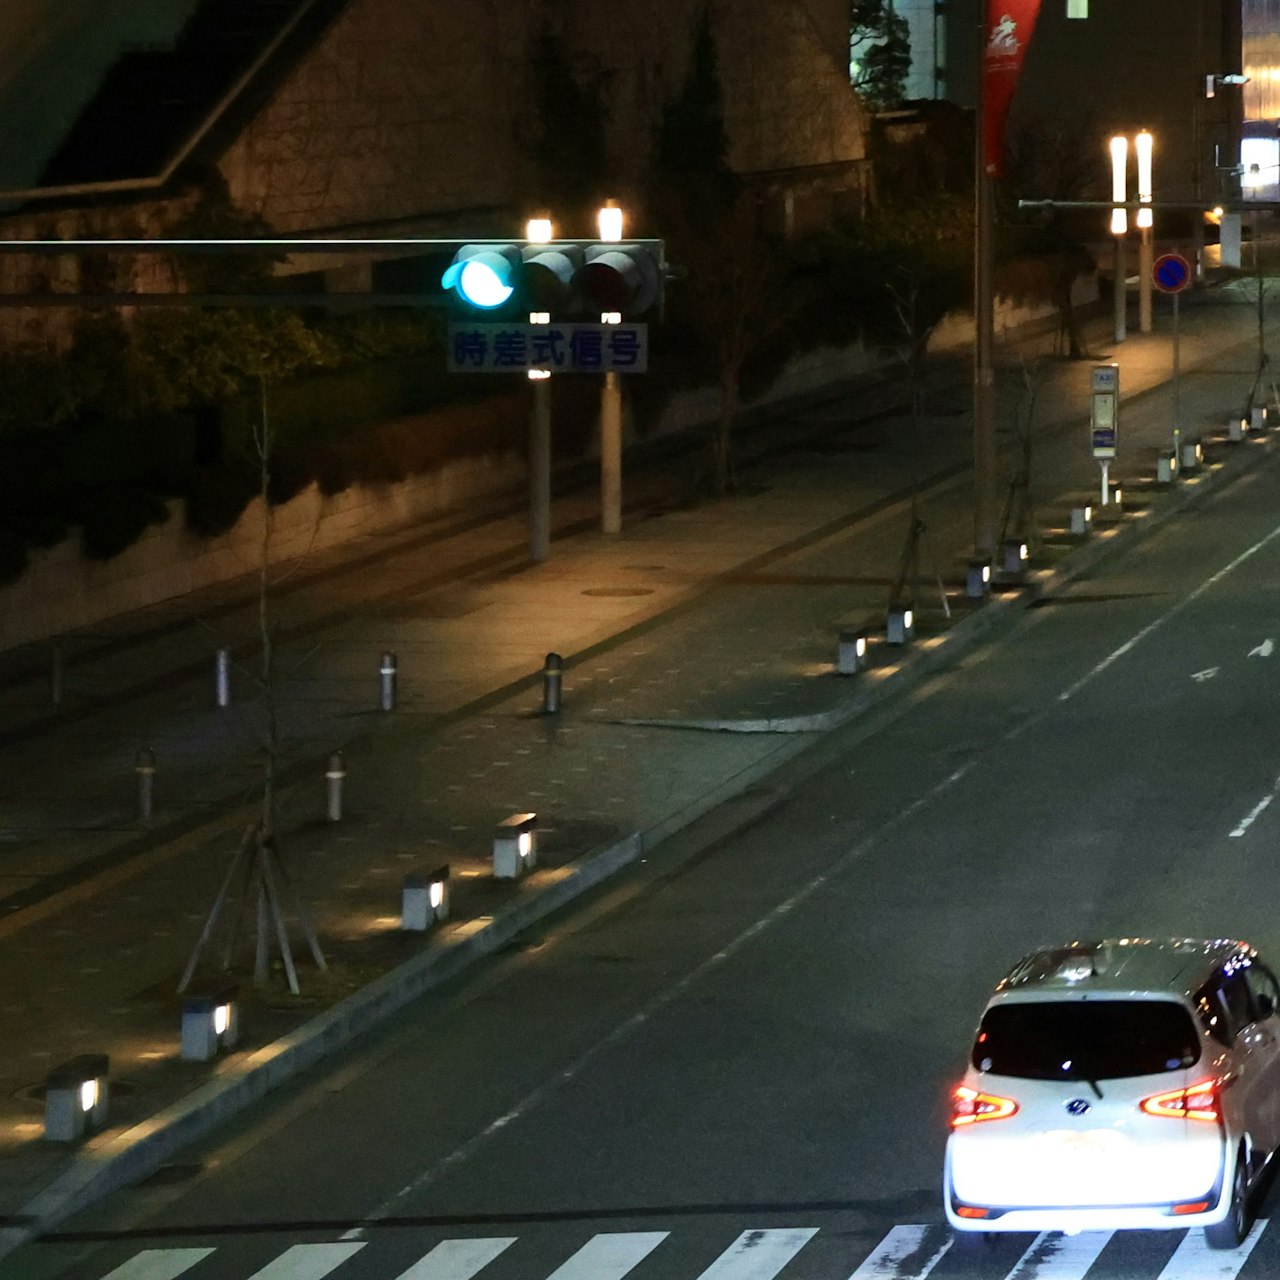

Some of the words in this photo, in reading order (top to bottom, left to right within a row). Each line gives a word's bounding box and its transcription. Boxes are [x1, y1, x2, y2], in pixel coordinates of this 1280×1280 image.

[454, 329, 641, 366] 時差式信号
